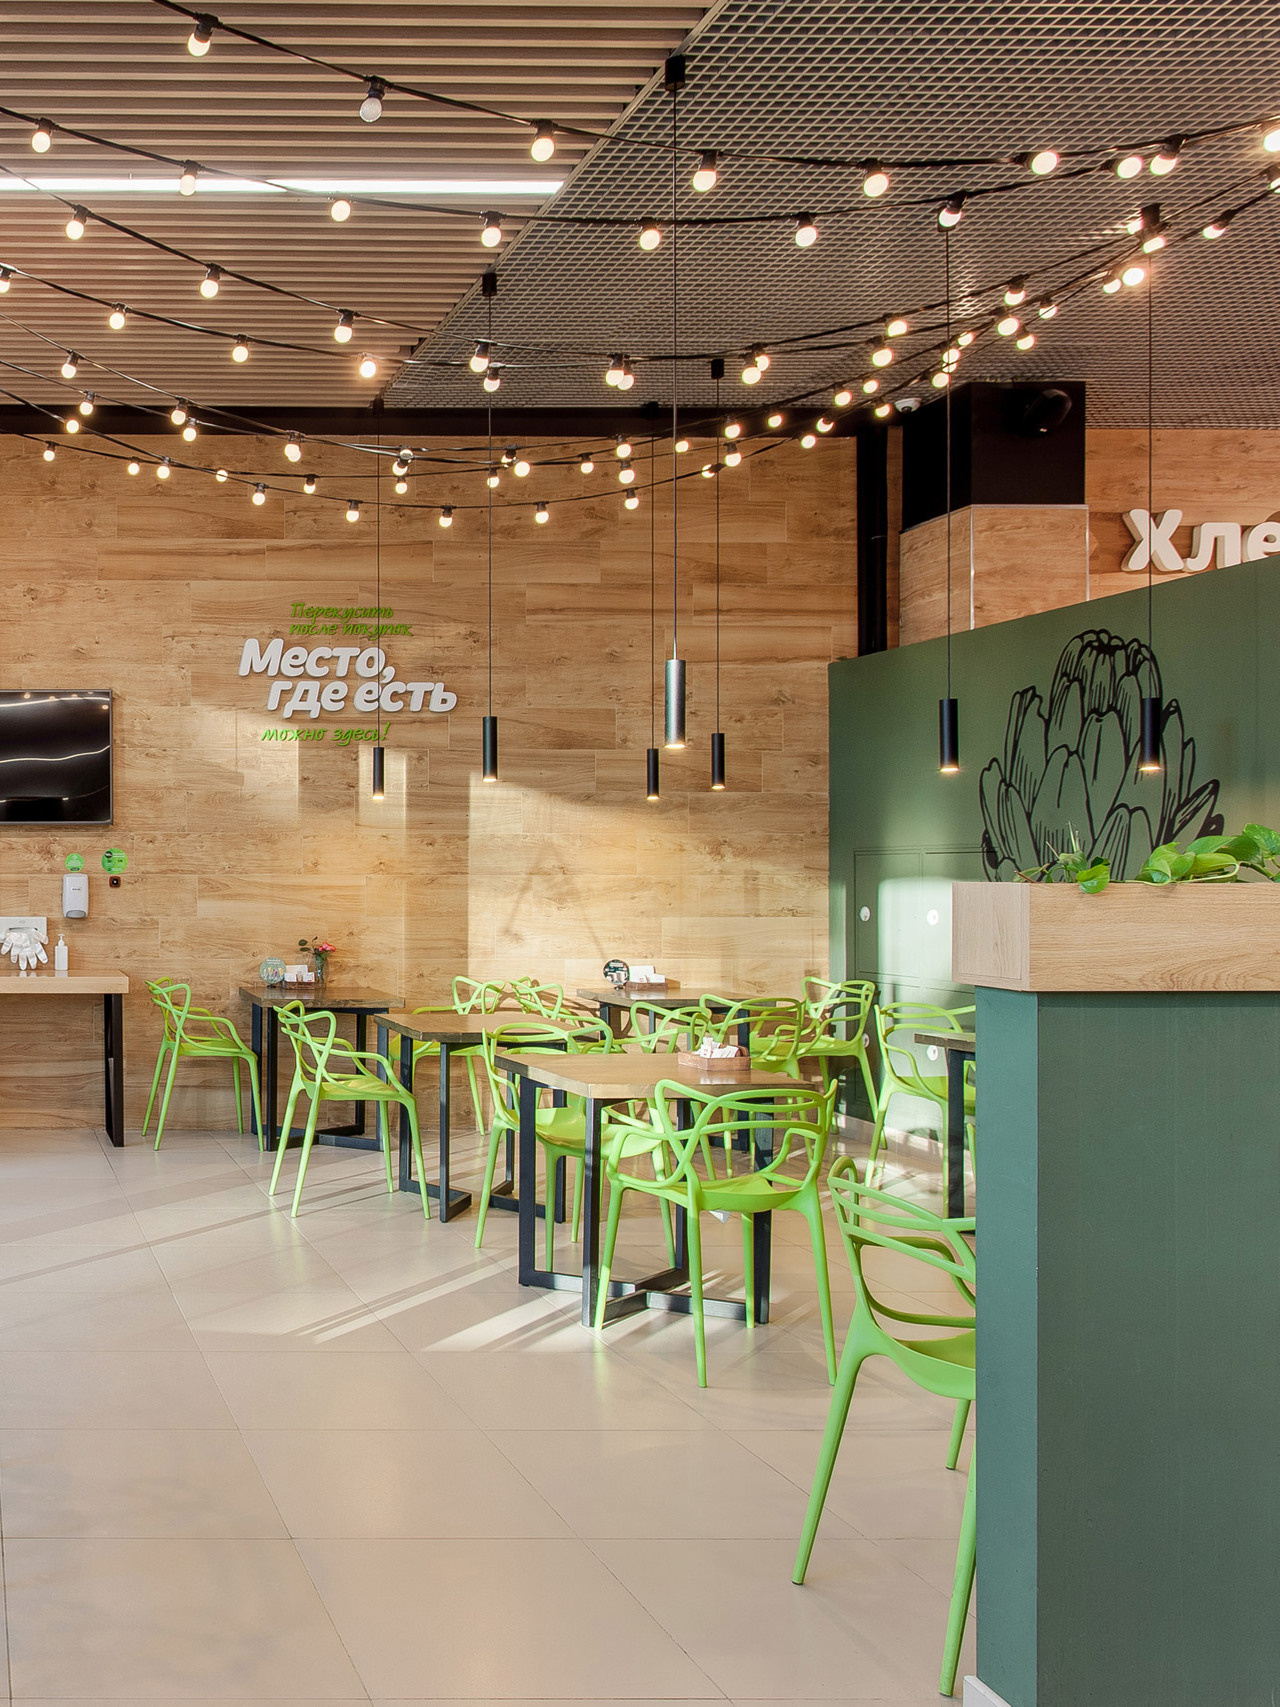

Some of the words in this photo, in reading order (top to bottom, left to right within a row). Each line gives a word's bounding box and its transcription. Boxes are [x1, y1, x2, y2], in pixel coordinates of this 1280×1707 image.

[290, 602, 394, 624] Перекусить
[289, 623, 338, 636] после
[342, 623, 413, 641] покупок
[238, 637, 396, 684] Место,
[266, 680, 349, 719] где
[353, 680, 458, 713] есть
[260, 727, 328, 742] можно
[330, 721, 391, 746] здесь!
